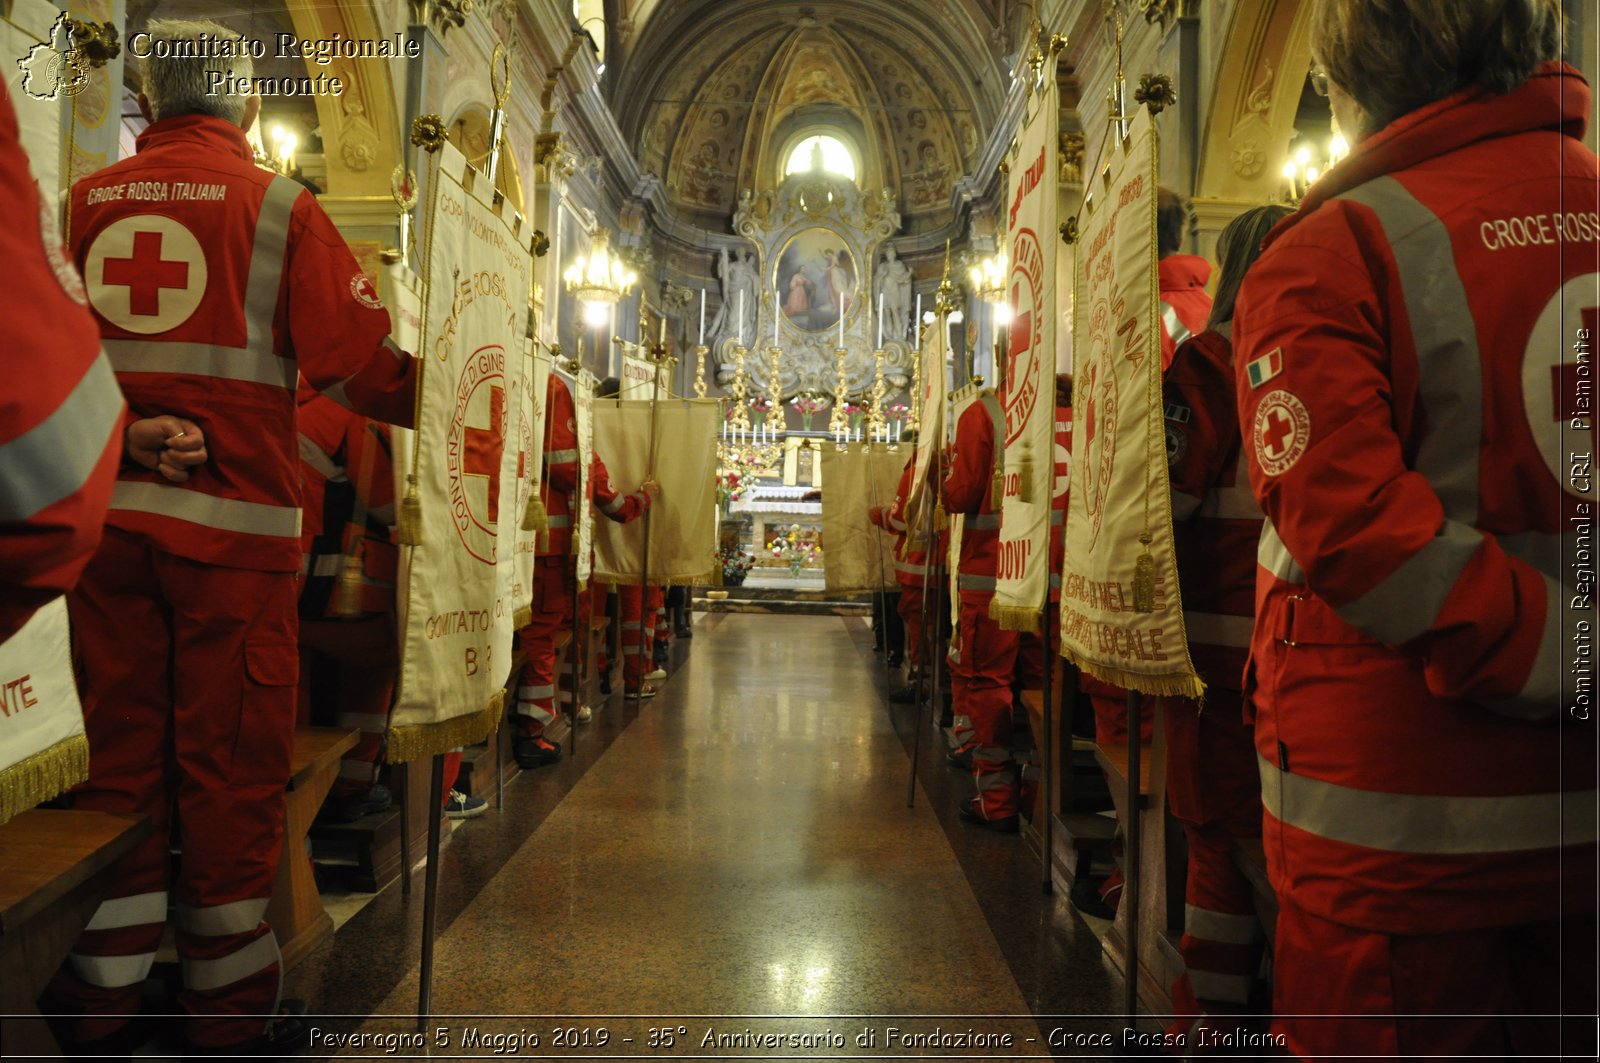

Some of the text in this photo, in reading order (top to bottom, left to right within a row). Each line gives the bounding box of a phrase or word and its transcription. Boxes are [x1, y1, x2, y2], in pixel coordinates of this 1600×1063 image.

[87, 181, 227, 205] CROCE ROSSA ITALIANA
[1480, 214, 1555, 251] CROCE
[467, 364, 478, 381] DI
[425, 610, 490, 640] COMITATO
[1096, 622, 1168, 661] LOCALE
